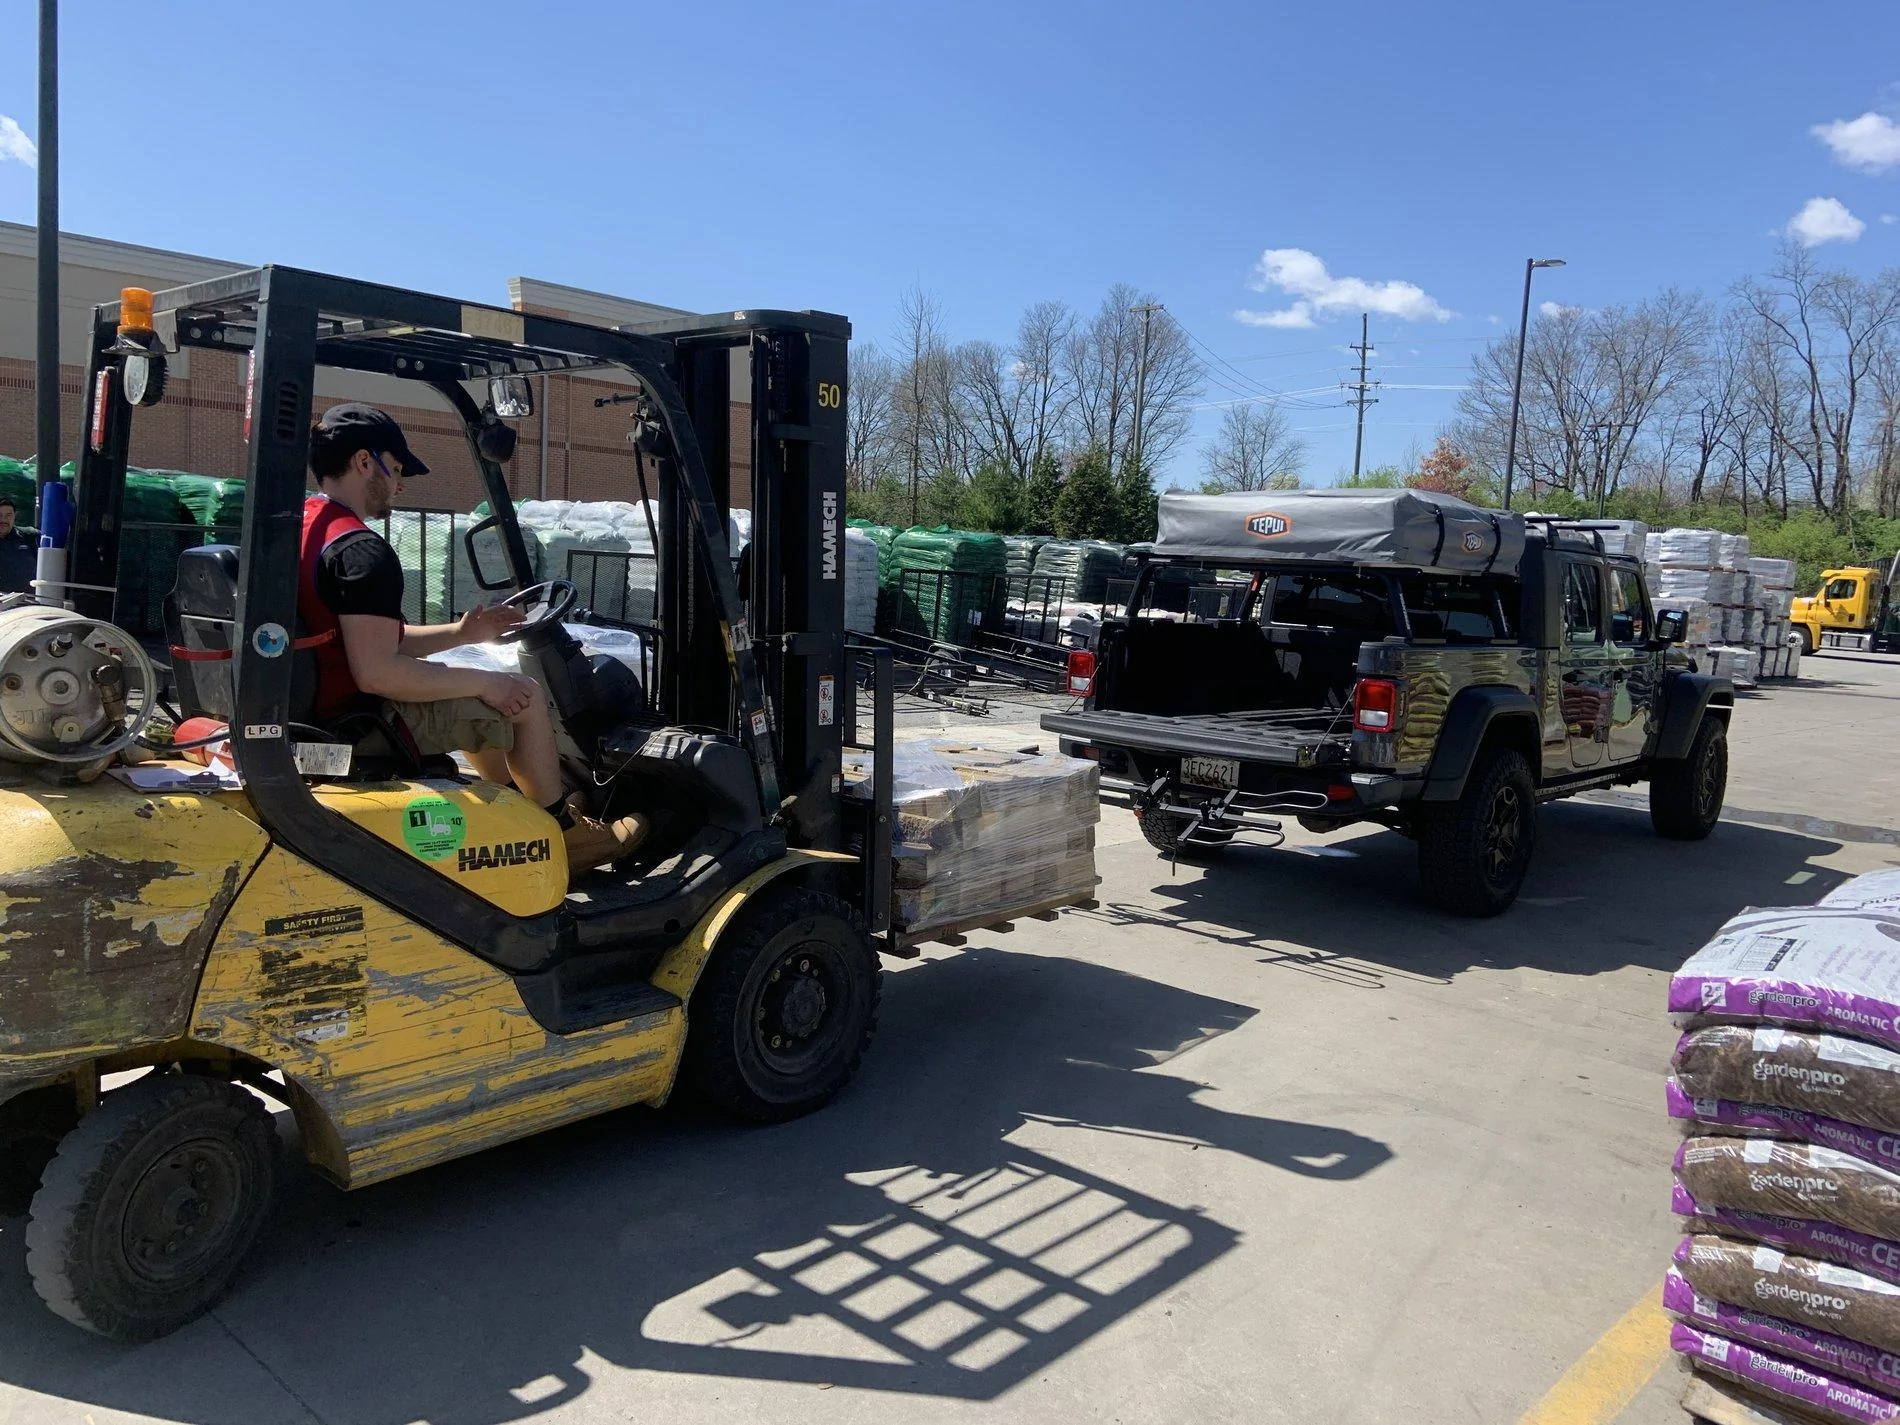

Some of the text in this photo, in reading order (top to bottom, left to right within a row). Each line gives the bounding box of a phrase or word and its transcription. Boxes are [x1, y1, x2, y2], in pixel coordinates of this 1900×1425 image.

[818, 383, 840, 409] 50
[822, 491, 837, 580] HAMECH
[1251, 516, 1285, 535] TEPUI
[458, 838, 551, 872] HAMECH
[1749, 986, 1817, 1008] gardenpro
[1826, 1006, 1890, 1031] AROMATIC
[1753, 1058, 1846, 1085] gardenpro
[1813, 1123, 1873, 1151] AROMATIC
[1749, 1171, 1839, 1192] gardenpro
[1811, 1229, 1868, 1257] AROMATIC
[1754, 1277, 1846, 1309] gardenpro
[1739, 1311, 1806, 1339] gardenpro
[1814, 1340, 1874, 1367] AROMATIC
[1750, 1354, 1819, 1386] gardenpro
[1827, 1388, 1888, 1420] AROMATIC
